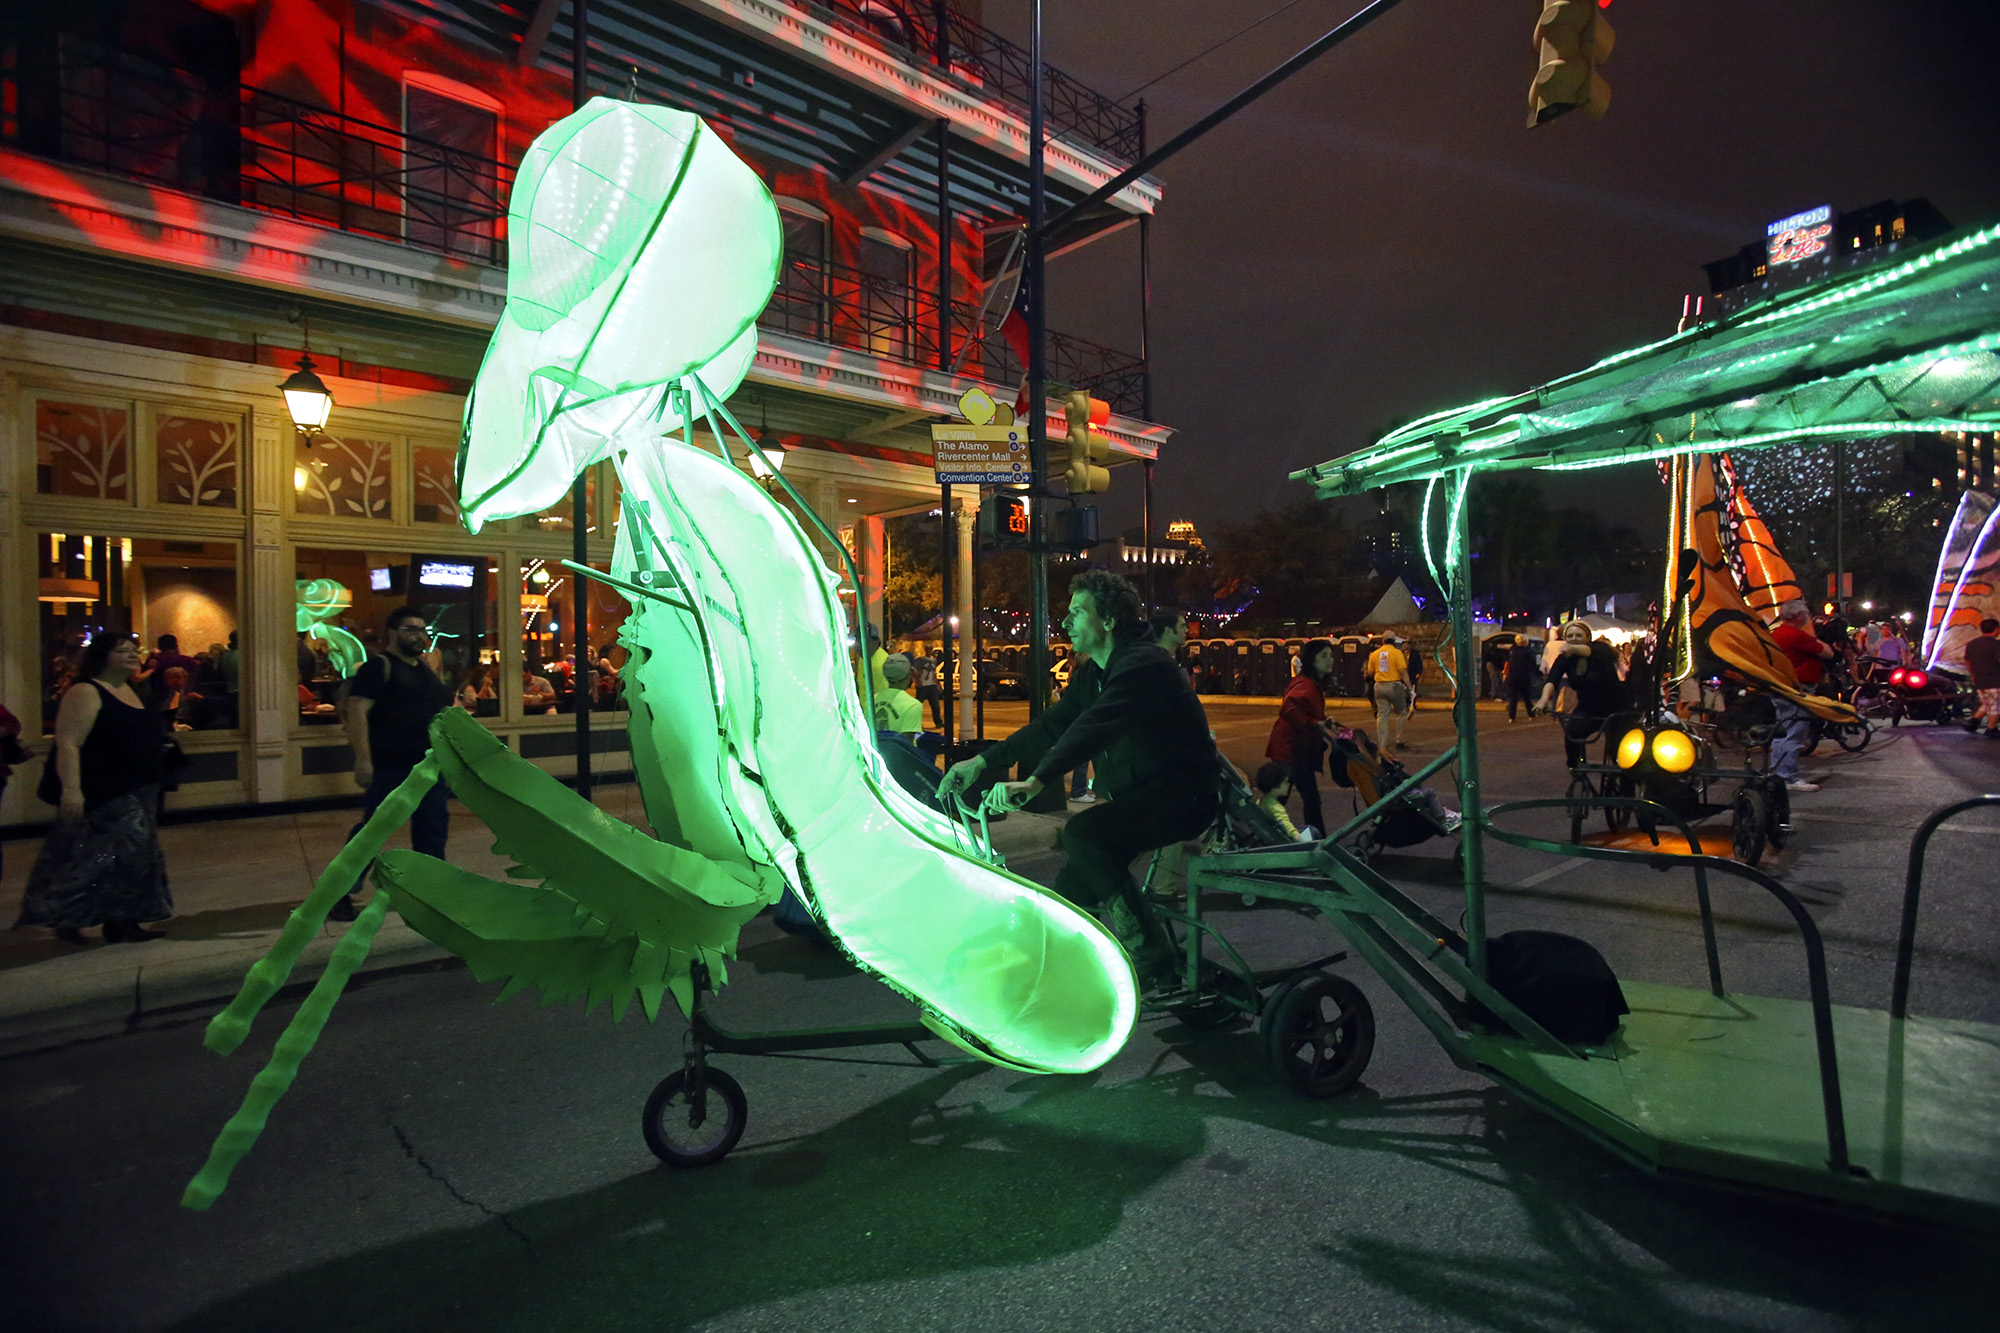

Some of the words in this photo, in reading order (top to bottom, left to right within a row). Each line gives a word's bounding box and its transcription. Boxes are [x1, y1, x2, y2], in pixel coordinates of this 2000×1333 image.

[1767, 206, 1831, 236] HILTON
[1770, 225, 1831, 252] Placio
[1790, 239, 1825, 262] Rio
[936, 431, 948, 439] La
[950, 431, 977, 440] Villita
[936, 441, 955, 450] The
[958, 441, 989, 450] Alamo
[937, 452, 990, 461] Rivercenter
[992, 452, 1011, 461] Mall
[939, 463, 964, 471] Visitor
[966, 463, 983, 471] Info.
[985, 463, 1011, 471] Center
[940, 473, 985, 482] Convention
[987, 473, 1013, 482] Center
